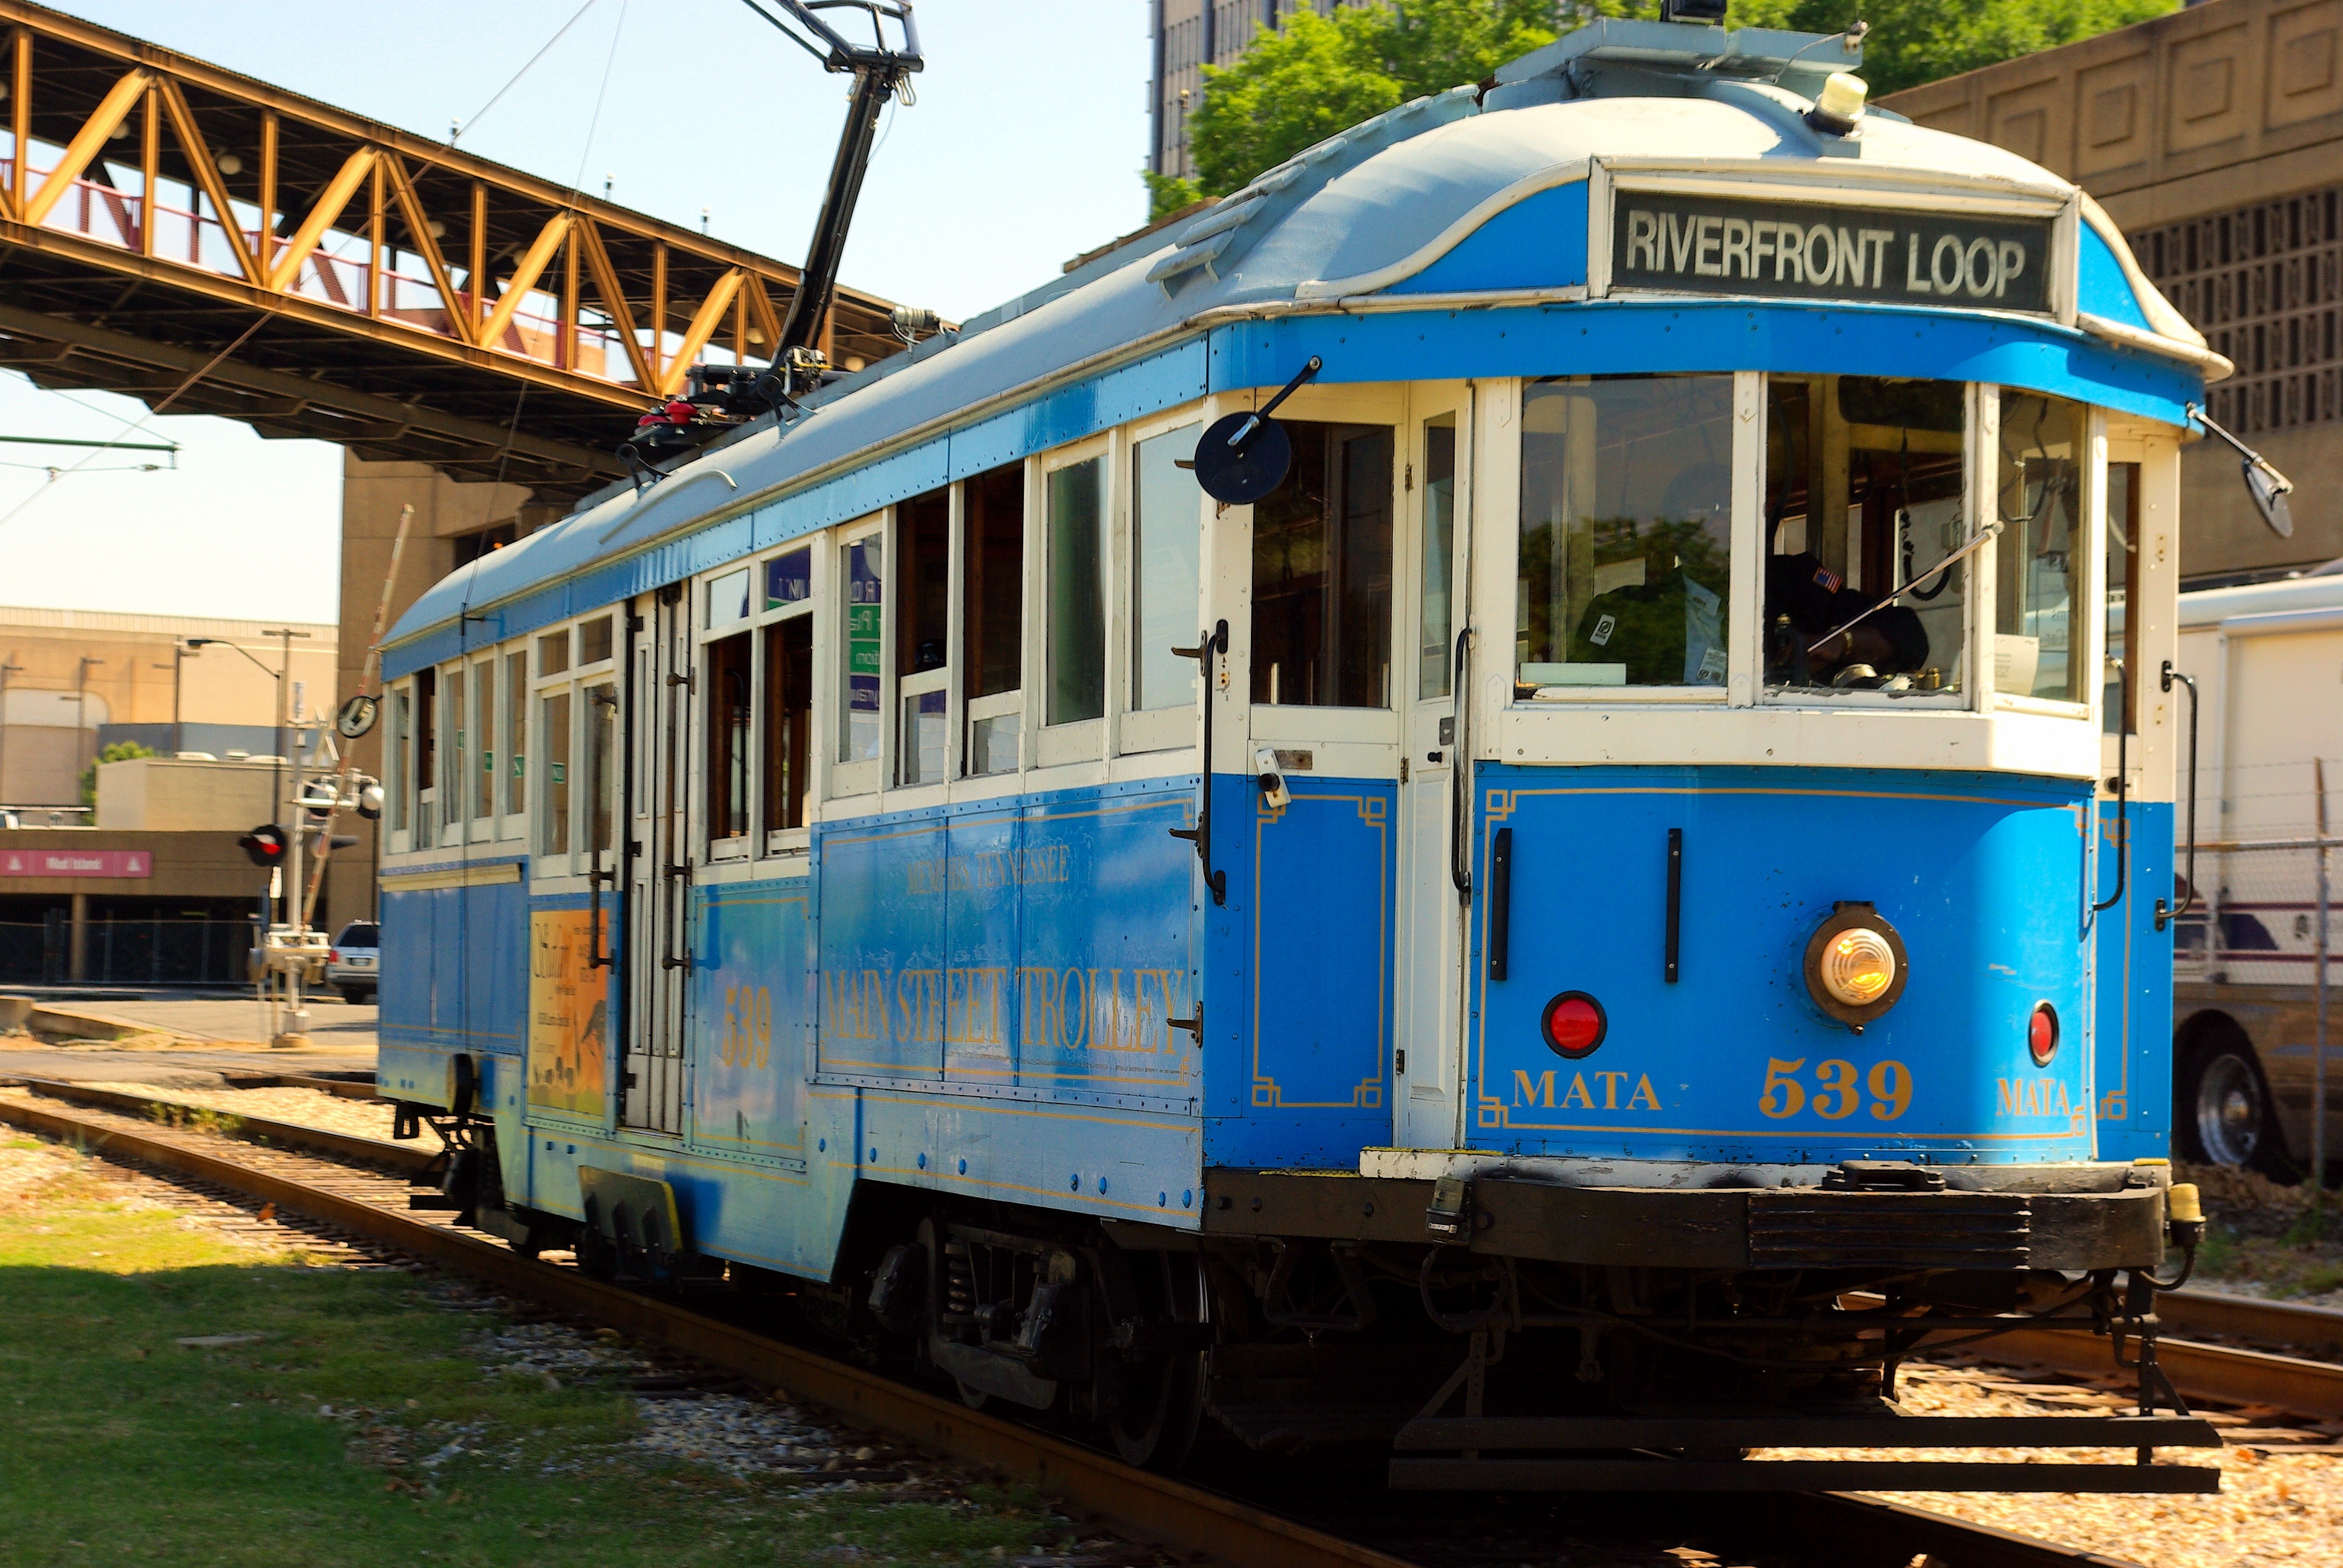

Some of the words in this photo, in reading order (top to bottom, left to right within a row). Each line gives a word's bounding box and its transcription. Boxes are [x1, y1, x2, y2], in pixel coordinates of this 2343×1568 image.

[1626, 209, 1894, 289] RIVERFRONT
[1906, 232, 2025, 299] LOOP
[977, 845, 1069, 887] TENNESSEE
[723, 985, 772, 1070] 539
[824, 969, 893, 1039] MAIN
[897, 967, 1006, 1044] STREET
[1020, 966, 1184, 1055] TROLLEY
[1512, 1070, 1662, 1111] MATA
[1758, 1057, 1912, 1122] 539
[1996, 1078, 2069, 1117] MATA
